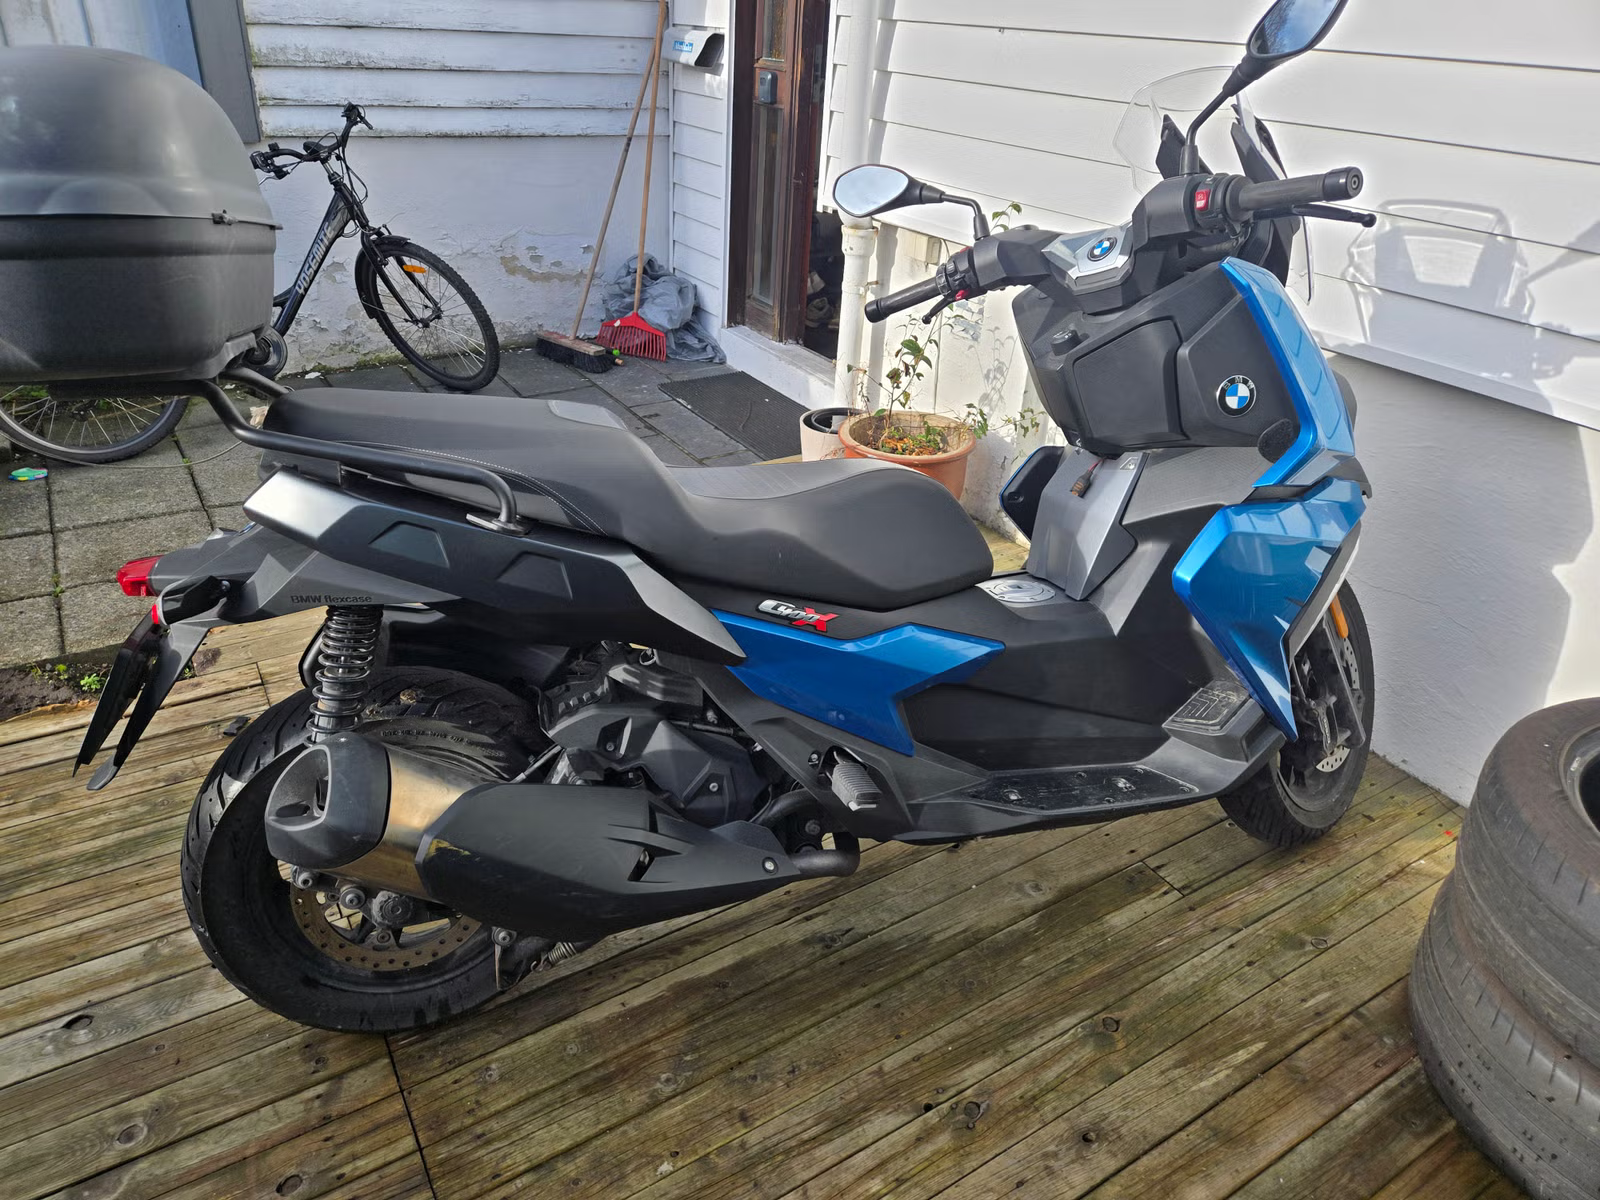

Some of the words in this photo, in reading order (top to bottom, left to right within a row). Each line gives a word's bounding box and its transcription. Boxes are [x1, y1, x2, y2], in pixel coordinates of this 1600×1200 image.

[295, 221, 335, 295] YOSEMITE
[290, 594, 322, 604] BMW
[323, 594, 372, 604] flexcase
